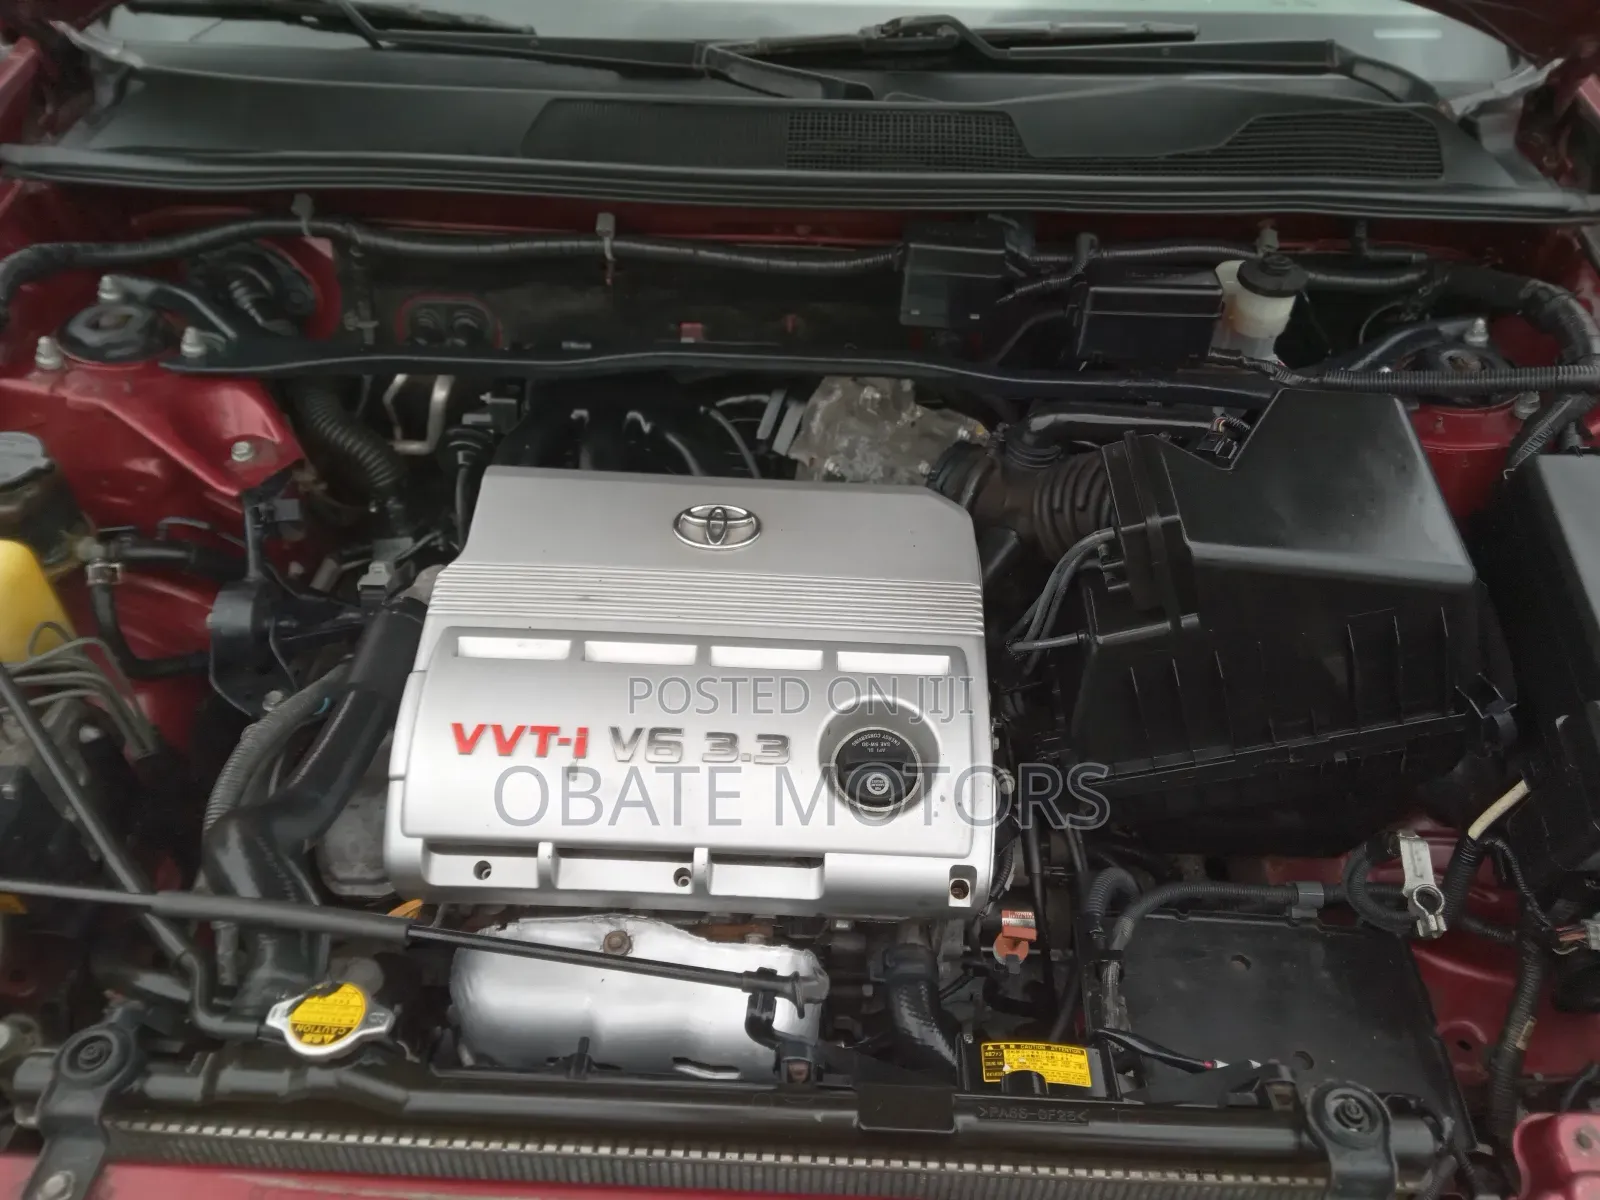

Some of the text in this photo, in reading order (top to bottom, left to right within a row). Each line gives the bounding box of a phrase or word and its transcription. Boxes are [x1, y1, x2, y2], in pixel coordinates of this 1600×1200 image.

[452, 723, 790, 765] VVT-i V6 3.3
[296, 1024, 346, 1035] CAUTION
